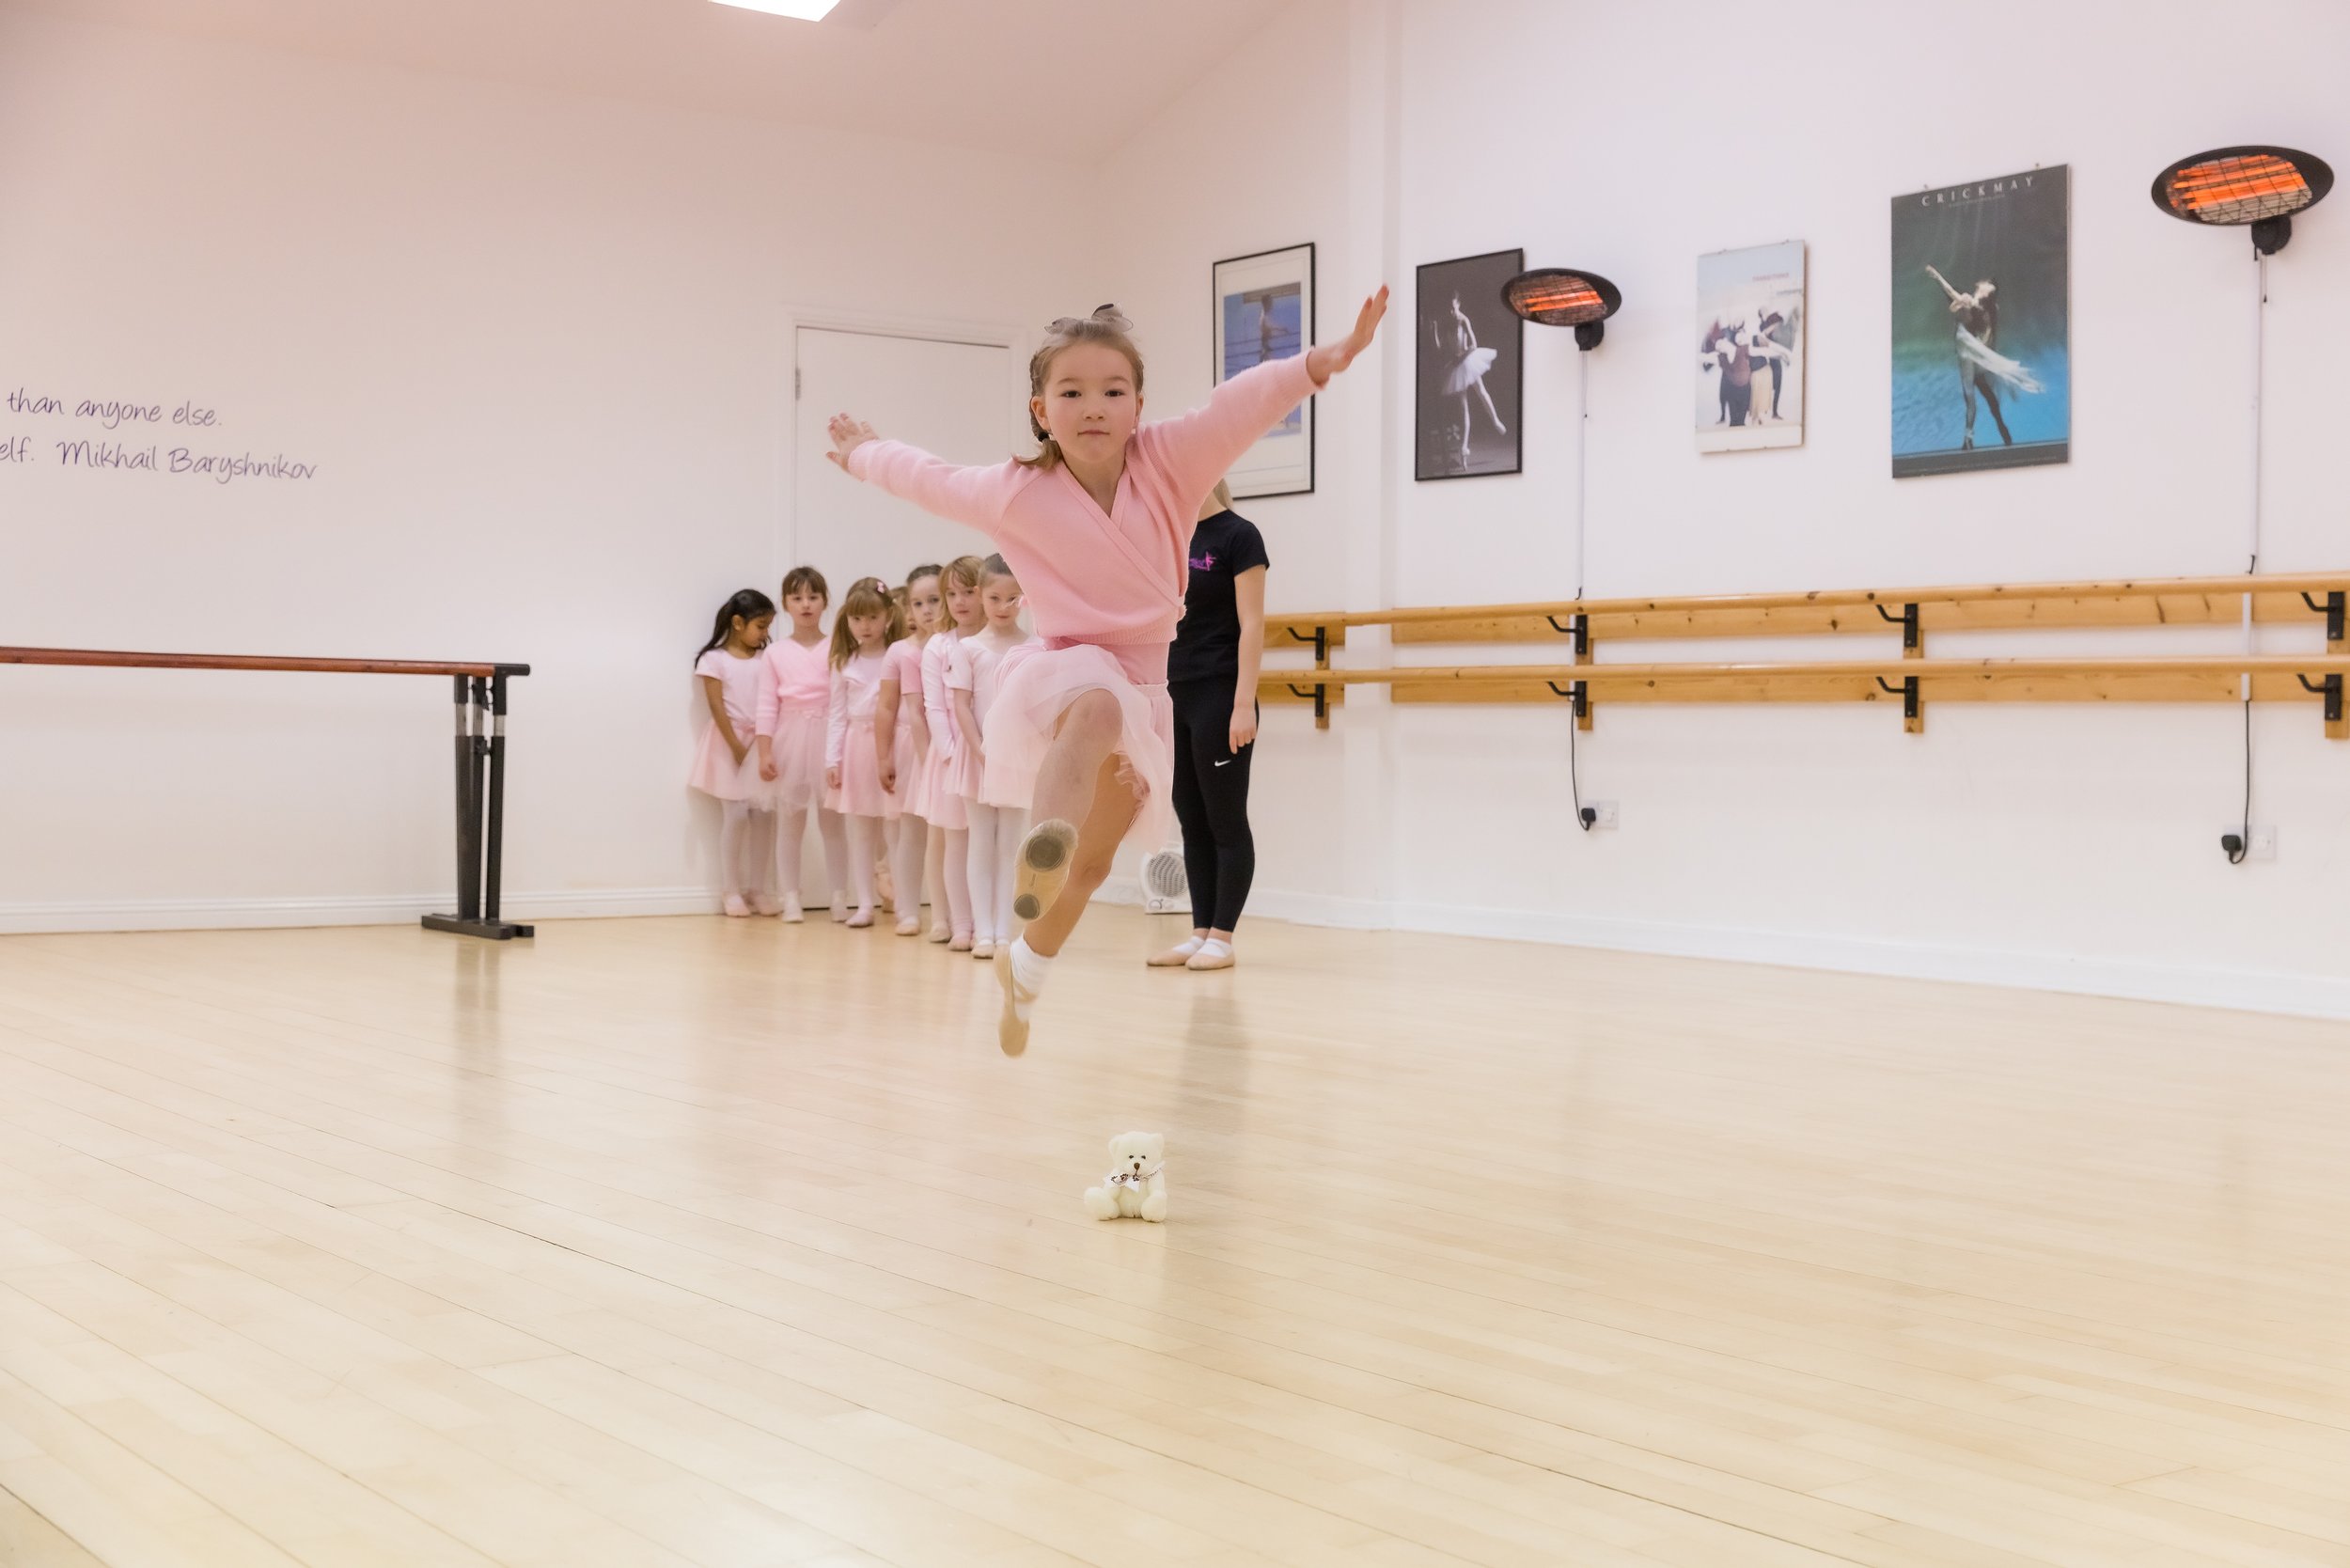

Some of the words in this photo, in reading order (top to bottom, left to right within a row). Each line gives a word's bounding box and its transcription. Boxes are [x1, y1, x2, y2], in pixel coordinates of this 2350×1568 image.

[1921, 176, 2033, 207] CRICKMAY
[7, 386, 65, 416] than
[75, 399, 163, 431] anyone
[172, 400, 222, 427] else.
[55, 439, 159, 472] Mikhail
[167, 447, 319, 485] Baryshnikov
